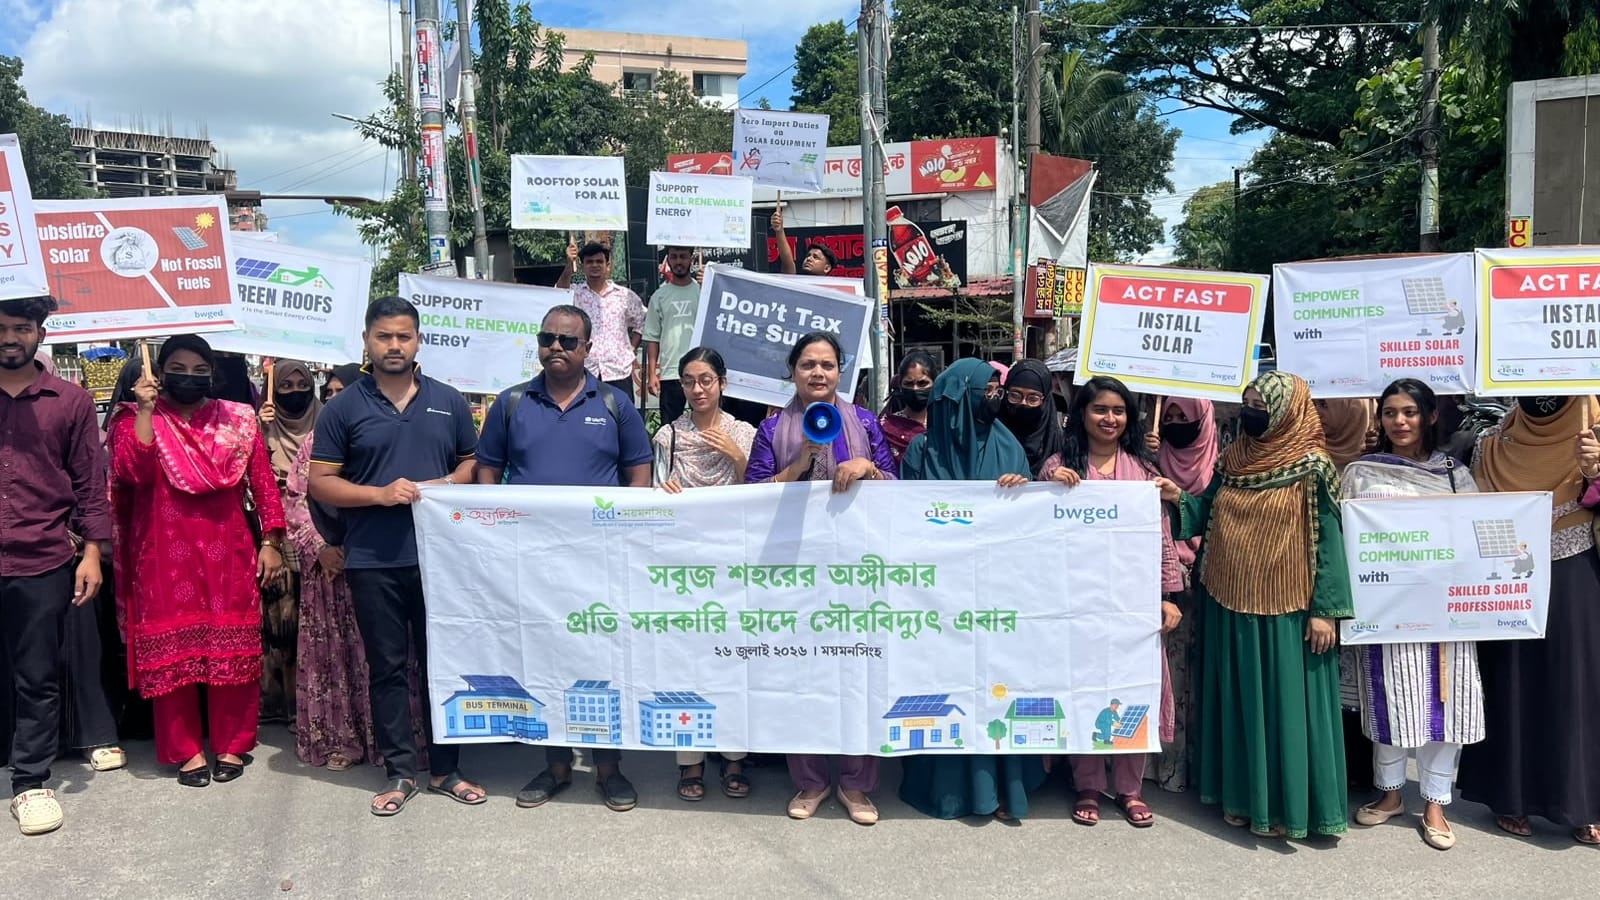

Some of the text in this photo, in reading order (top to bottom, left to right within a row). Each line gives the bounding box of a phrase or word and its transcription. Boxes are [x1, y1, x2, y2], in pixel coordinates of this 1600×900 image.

[741, 117, 819, 129] Zero Import Duties
[744, 136, 816, 148] SOLAR EQUIPMENT
[527, 177, 620, 187] ROOFTOP SOLAR
[656, 184, 699, 194] SUPPORT
[575, 191, 620, 200] FOR ALL
[656, 196, 745, 208] LOCAL RENEWABLE
[655, 208, 692, 217] ENERGY
[38, 222, 105, 241] ubsidize
[50, 247, 90, 264] Solar
[161, 255, 222, 273] Not Fossil
[177, 277, 211, 291] Fuels
[1065, 270, 1073, 303] UCC
[1075, 271, 1083, 303] UCC
[1519, 274, 1569, 292] ACT
[238, 284, 333, 314] REEN ROOFS
[411, 293, 483, 312] SUPPORT
[1122, 285, 1228, 306] ACT FAST
[1293, 289, 1360, 304] EMPOWER
[194, 309, 224, 320] bwged
[264, 309, 283, 317] Smart
[284, 312, 305, 320] Energy
[306, 314, 327, 322] Choice
[1293, 306, 1385, 321] COMMUNITIES
[1542, 303, 1600, 324] INSTA
[421, 313, 541, 336] OCAL RENEWAB
[716, 313, 758, 338] the
[795, 307, 843, 335] Tax
[1138, 311, 1202, 333] INSTALL
[419, 333, 471, 348] NERGY
[1294, 328, 1322, 340] with
[1550, 329, 1600, 349] SOLA
[1142, 334, 1193, 355] SOLAR
[1379, 339, 1460, 353] SKILLED SOLAR
[1379, 355, 1464, 368] PROFESSIONALS
[1211, 371, 1237, 381] bwged
[1430, 373, 1460, 384] bwged
[592, 506, 615, 520] fed
[925, 507, 974, 518] clean
[1053, 504, 1118, 524] bwged
[1359, 531, 1429, 544] EMPOWER
[1359, 548, 1455, 562] COMMUNITIES
[648, 554, 937, 595] সবুজ শহরের অঙ্গীকার
[1358, 571, 1389, 583] with
[1448, 583, 1528, 597] SKILLED SOLAR
[1447, 599, 1532, 613] PROFESSIONALS
[566, 600, 1018, 640] প্রতি সরকারি ছাদে সৌরবিদ্যুৎ এবার
[1497, 618, 1528, 628] bwged
[714, 646, 732, 657] ২৬
[736, 643, 769, 660] জুলাই
[773, 646, 807, 657] ২০২৬
[821, 643, 882, 659] ময়মনসিংহ
[465, 701, 528, 711] BUS TERMINAL
